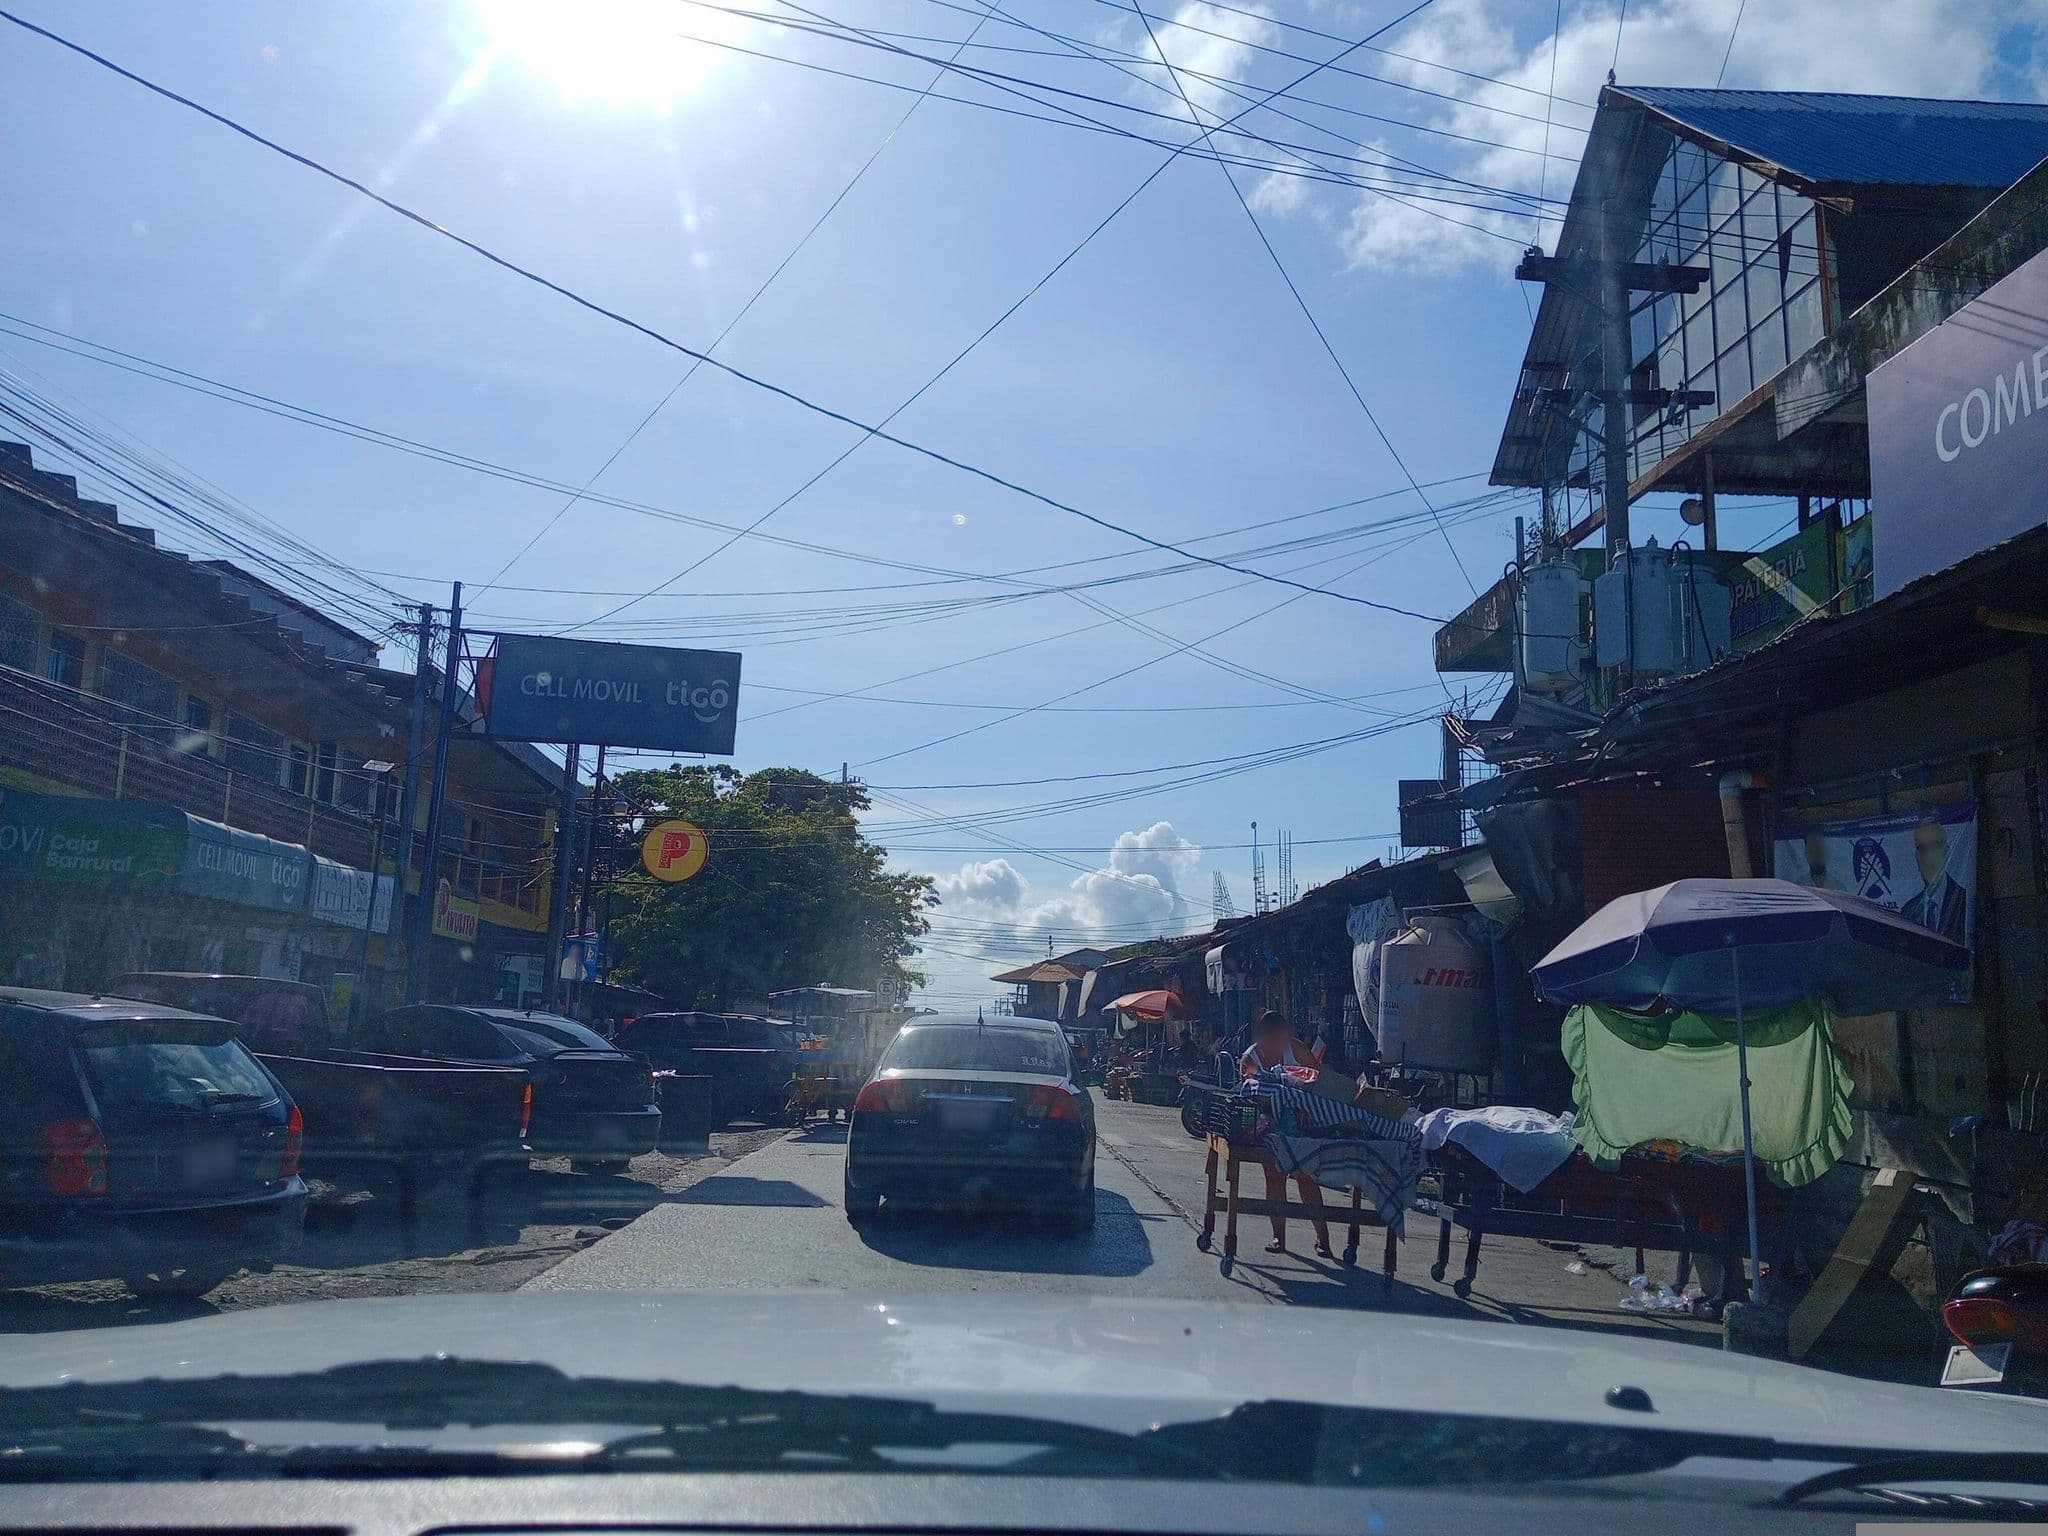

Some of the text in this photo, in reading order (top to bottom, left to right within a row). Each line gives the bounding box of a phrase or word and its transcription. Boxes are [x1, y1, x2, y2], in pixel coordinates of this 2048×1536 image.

[1935, 344, 2048, 462] COME
[520, 673, 567, 697] CELL
[573, 677, 642, 703] MOVIL
[0, 825, 46, 853] OVI
[50, 834, 99, 854] Caja
[198, 842, 225, 873] CELL
[225, 851, 257, 880] MOVIL
